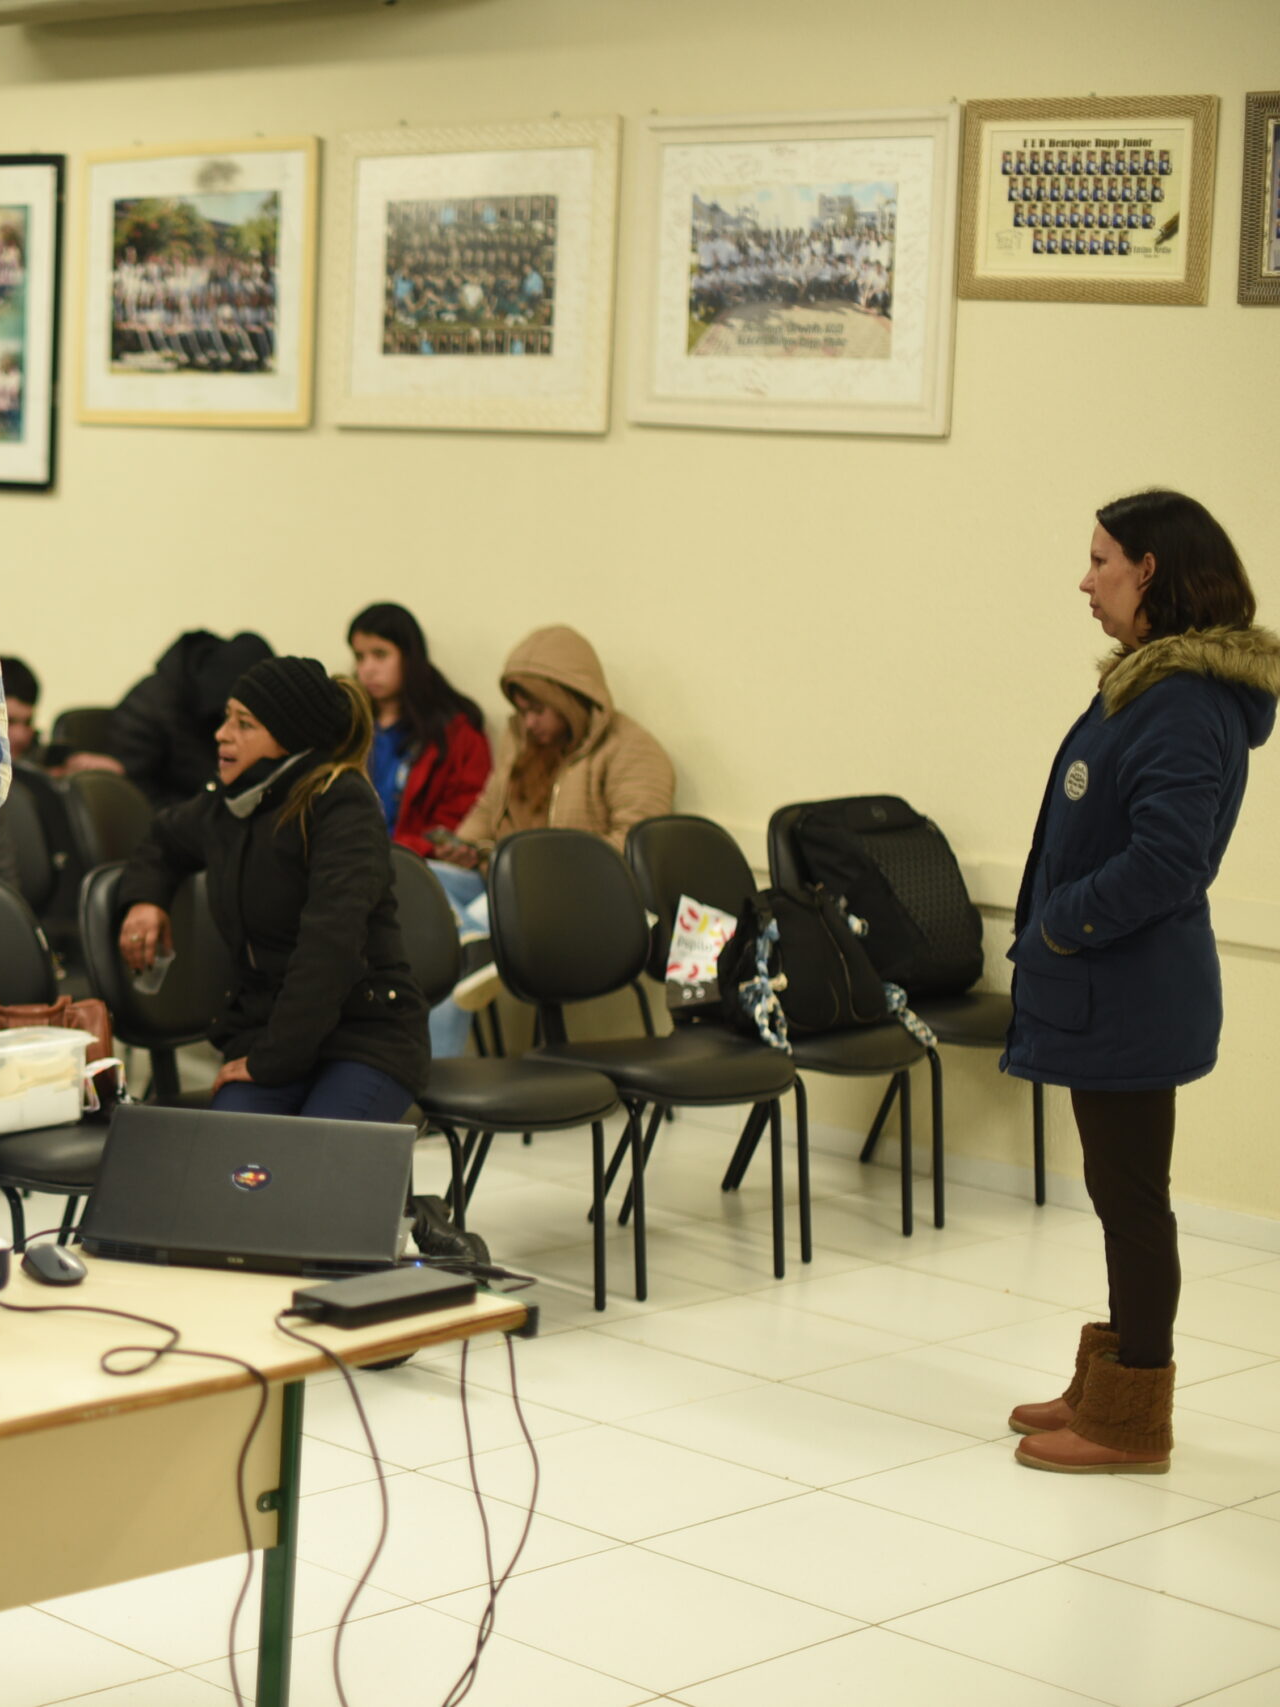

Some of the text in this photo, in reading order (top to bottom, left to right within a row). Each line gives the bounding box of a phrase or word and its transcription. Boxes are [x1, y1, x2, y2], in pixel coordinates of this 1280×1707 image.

[1048, 138, 1092, 149] Henrique
[1095, 138, 1120, 149] Rupp
[1122, 137, 1153, 148] Junior
